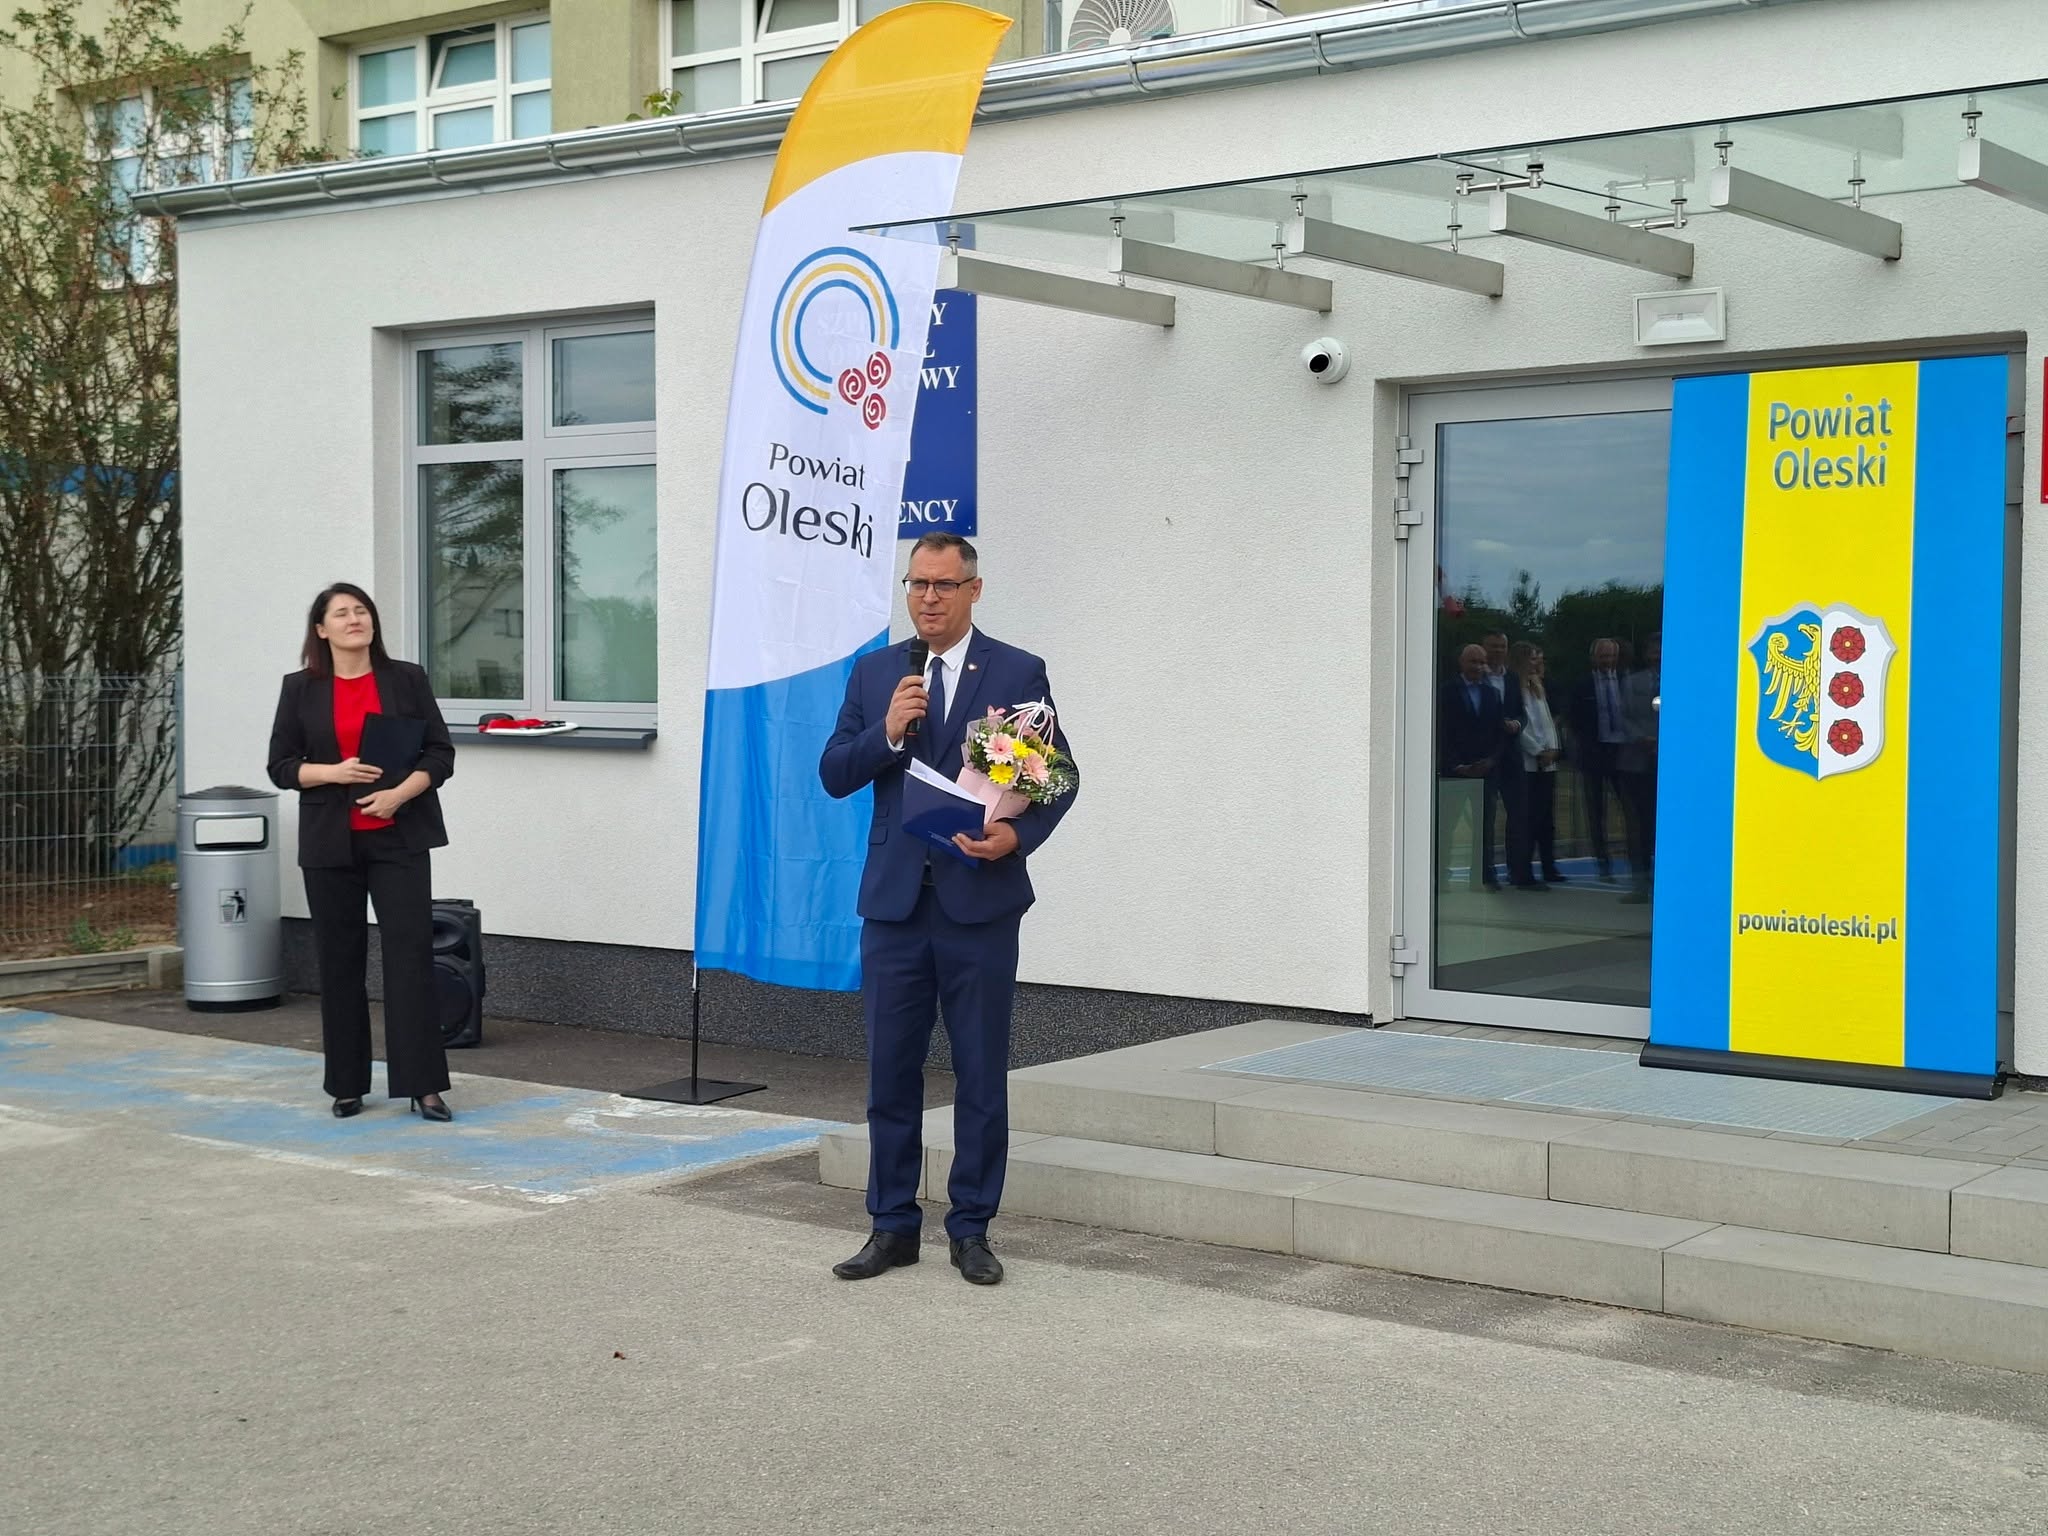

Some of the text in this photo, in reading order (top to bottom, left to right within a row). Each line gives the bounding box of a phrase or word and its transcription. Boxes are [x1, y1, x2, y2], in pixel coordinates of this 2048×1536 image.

[1769, 394, 1892, 441] Powiat
[769, 442, 866, 491] Powiat
[1773, 443, 1888, 491] Oleski
[742, 481, 873, 559] Oleski
[1737, 909, 1898, 944] powiatoleski.pl
